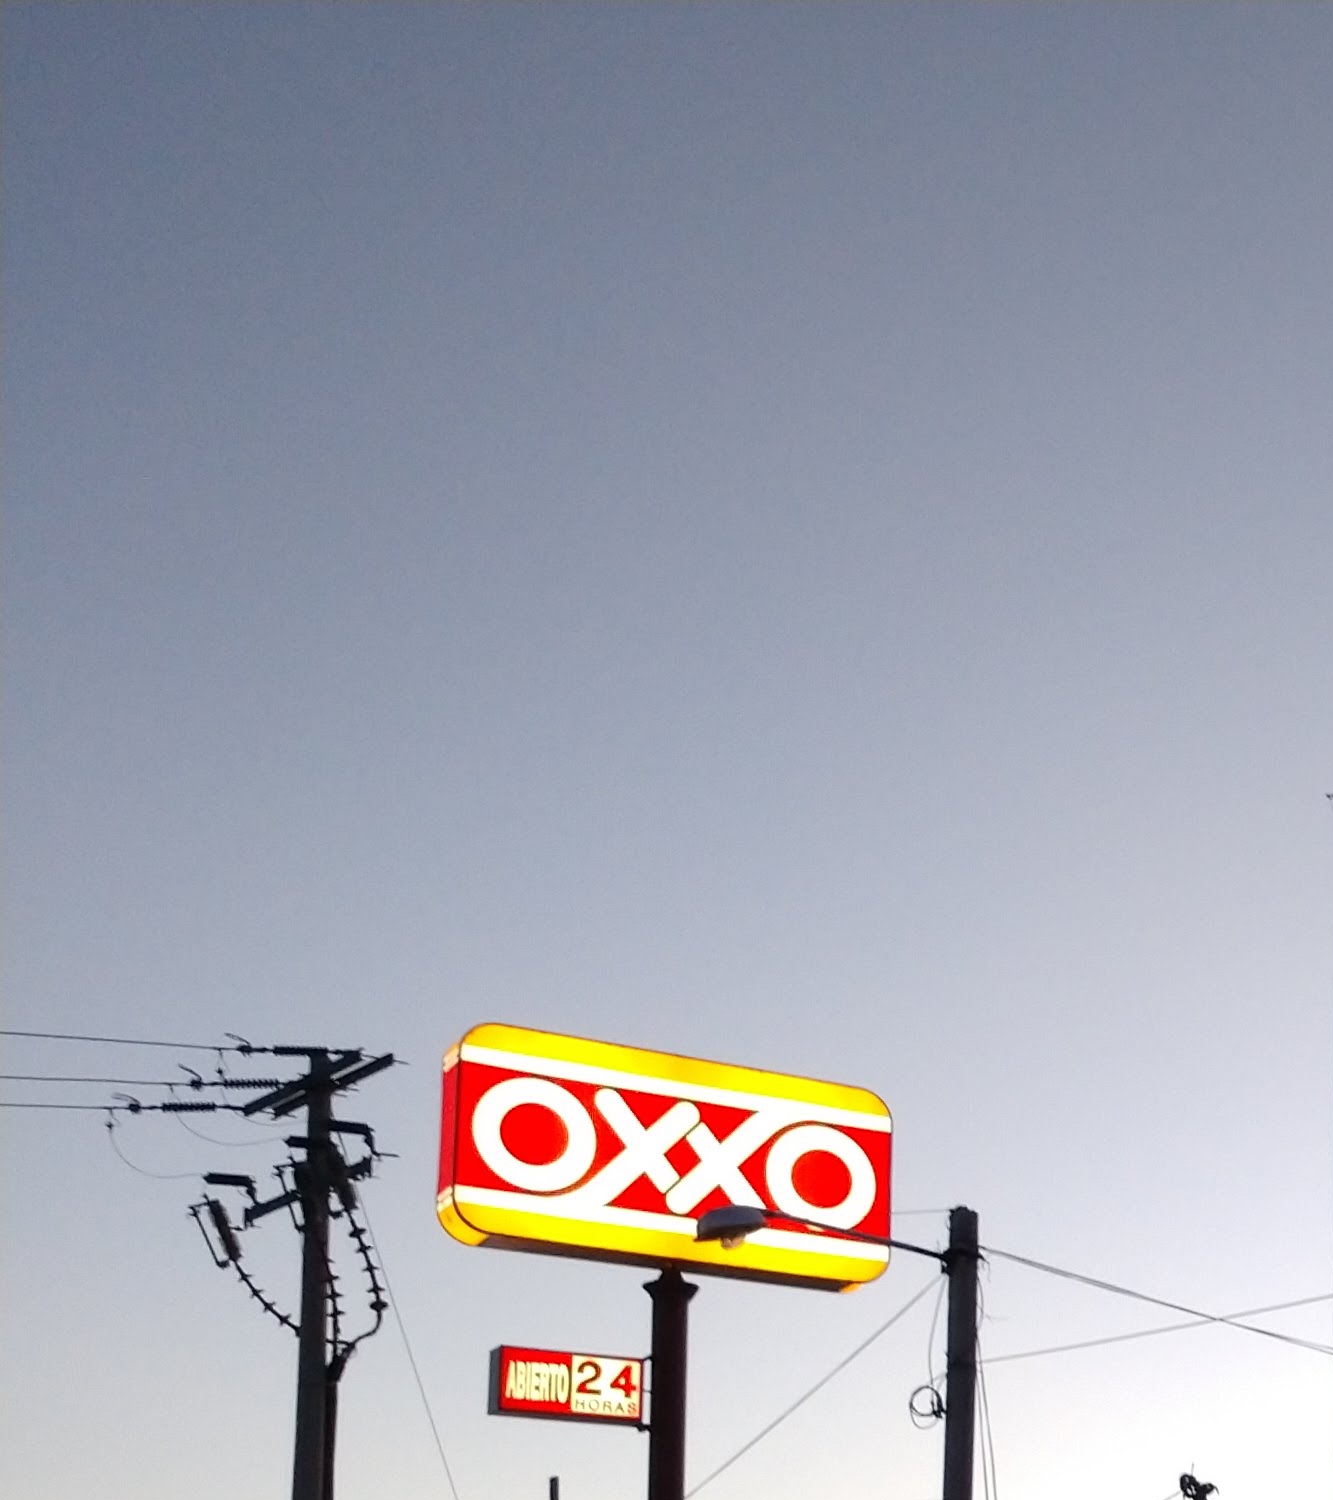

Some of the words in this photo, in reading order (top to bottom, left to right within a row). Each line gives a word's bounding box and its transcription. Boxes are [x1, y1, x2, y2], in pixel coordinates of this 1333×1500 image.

[472, 1076, 877, 1232] OXXO
[505, 1360, 570, 1404] ABIERTO
[576, 1361, 637, 1398] 24
[575, 1400, 637, 1415] HORAS
